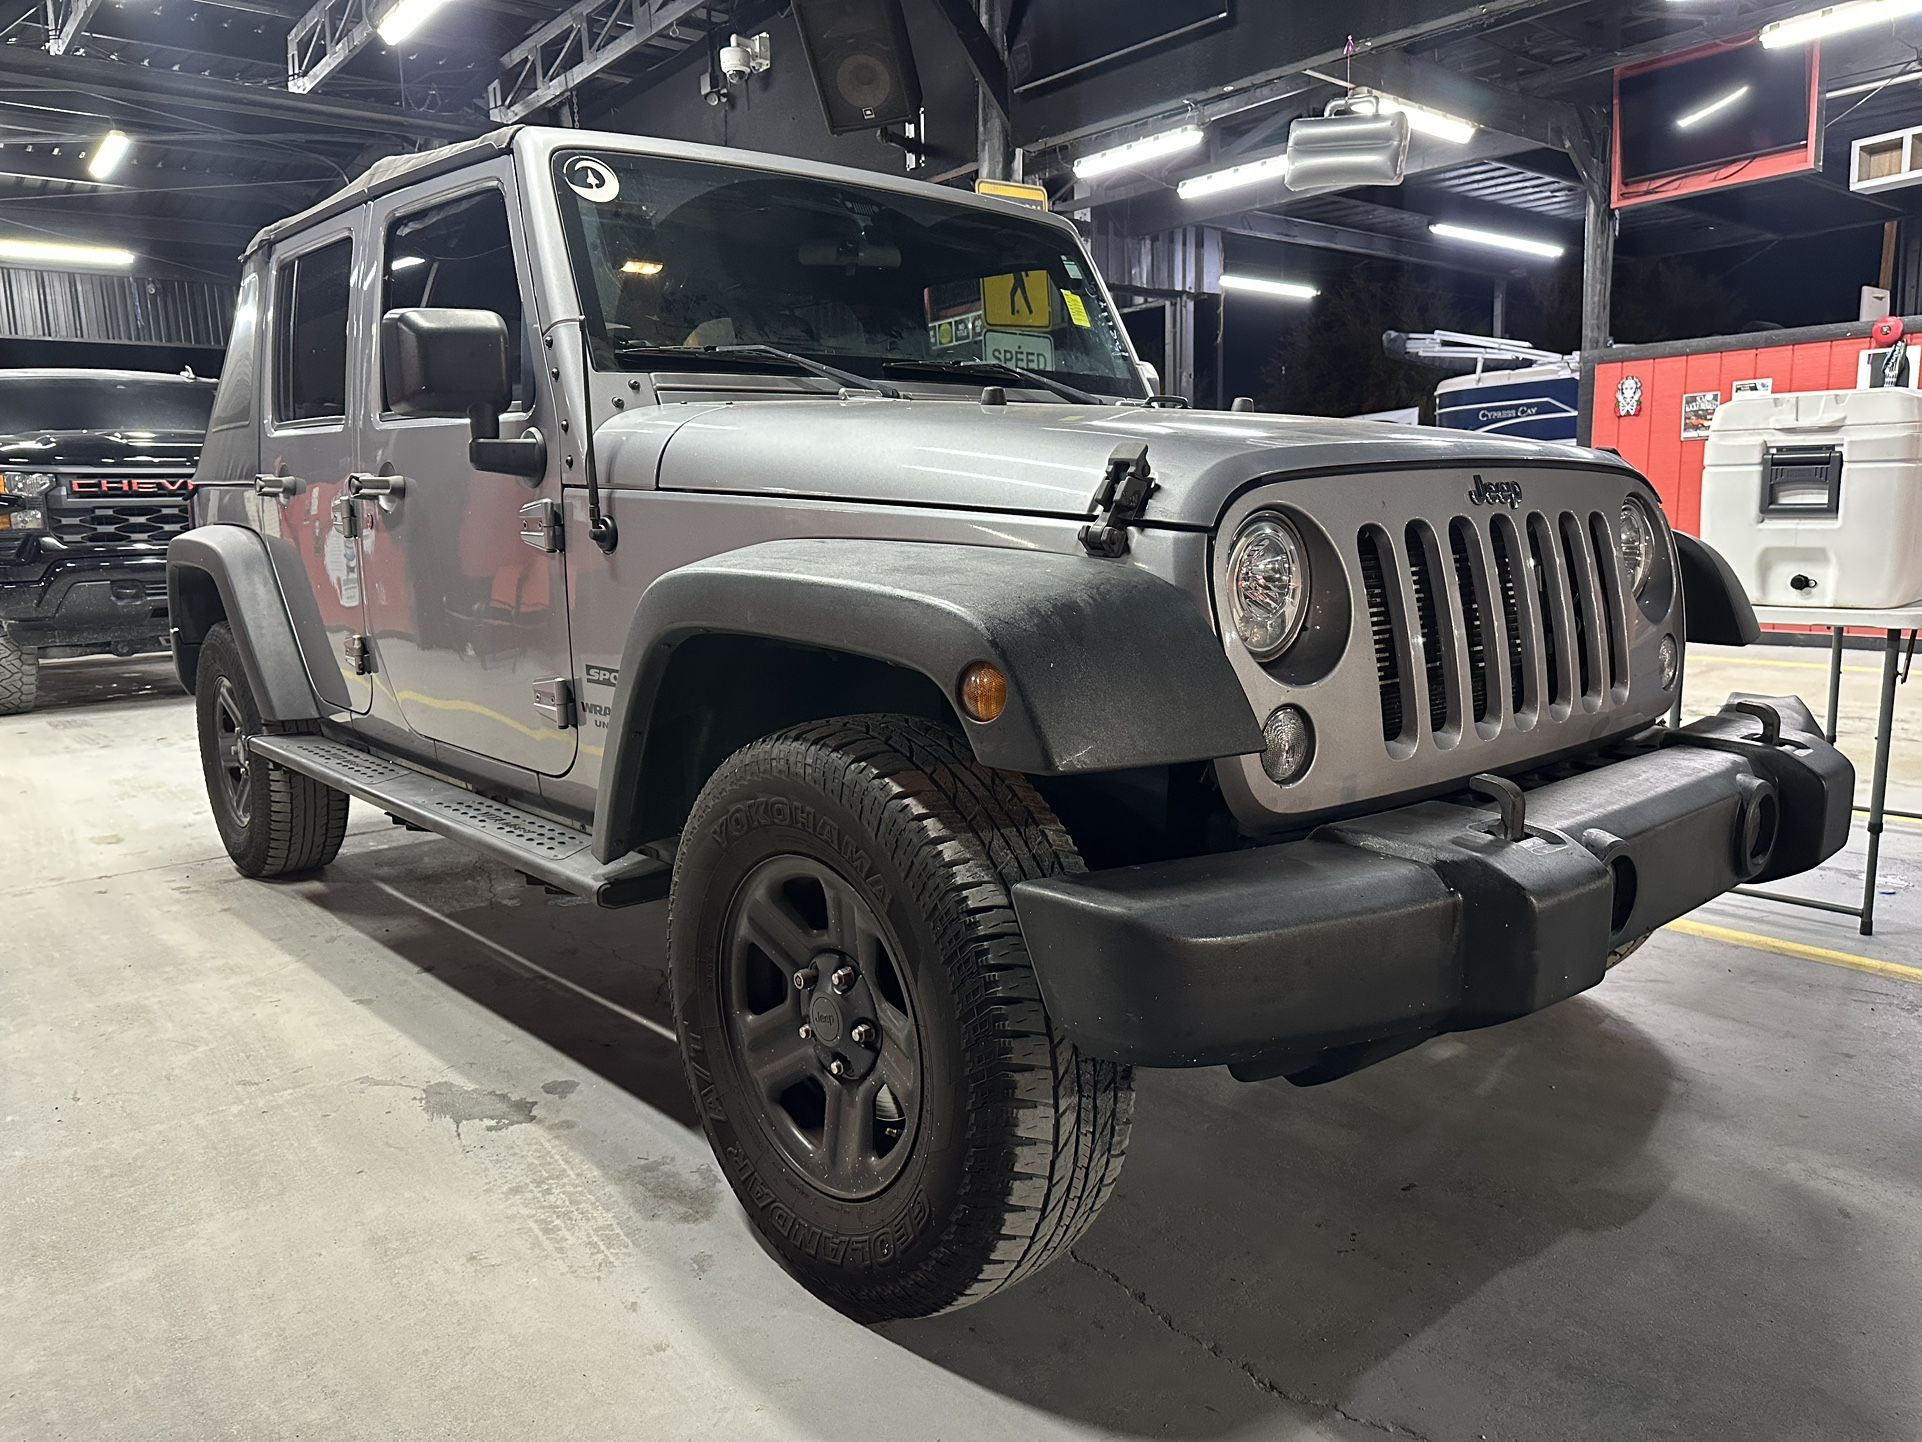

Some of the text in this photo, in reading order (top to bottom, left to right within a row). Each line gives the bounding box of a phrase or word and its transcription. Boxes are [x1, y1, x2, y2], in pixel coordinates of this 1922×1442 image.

[991, 348, 1047, 370] SPEED
[1468, 474, 1522, 510] Jeep
[710, 796, 891, 908] YOKOHAMA
[815, 1011, 835, 1027] Jeep
[727, 1143, 931, 1266] GEOLANDAR
